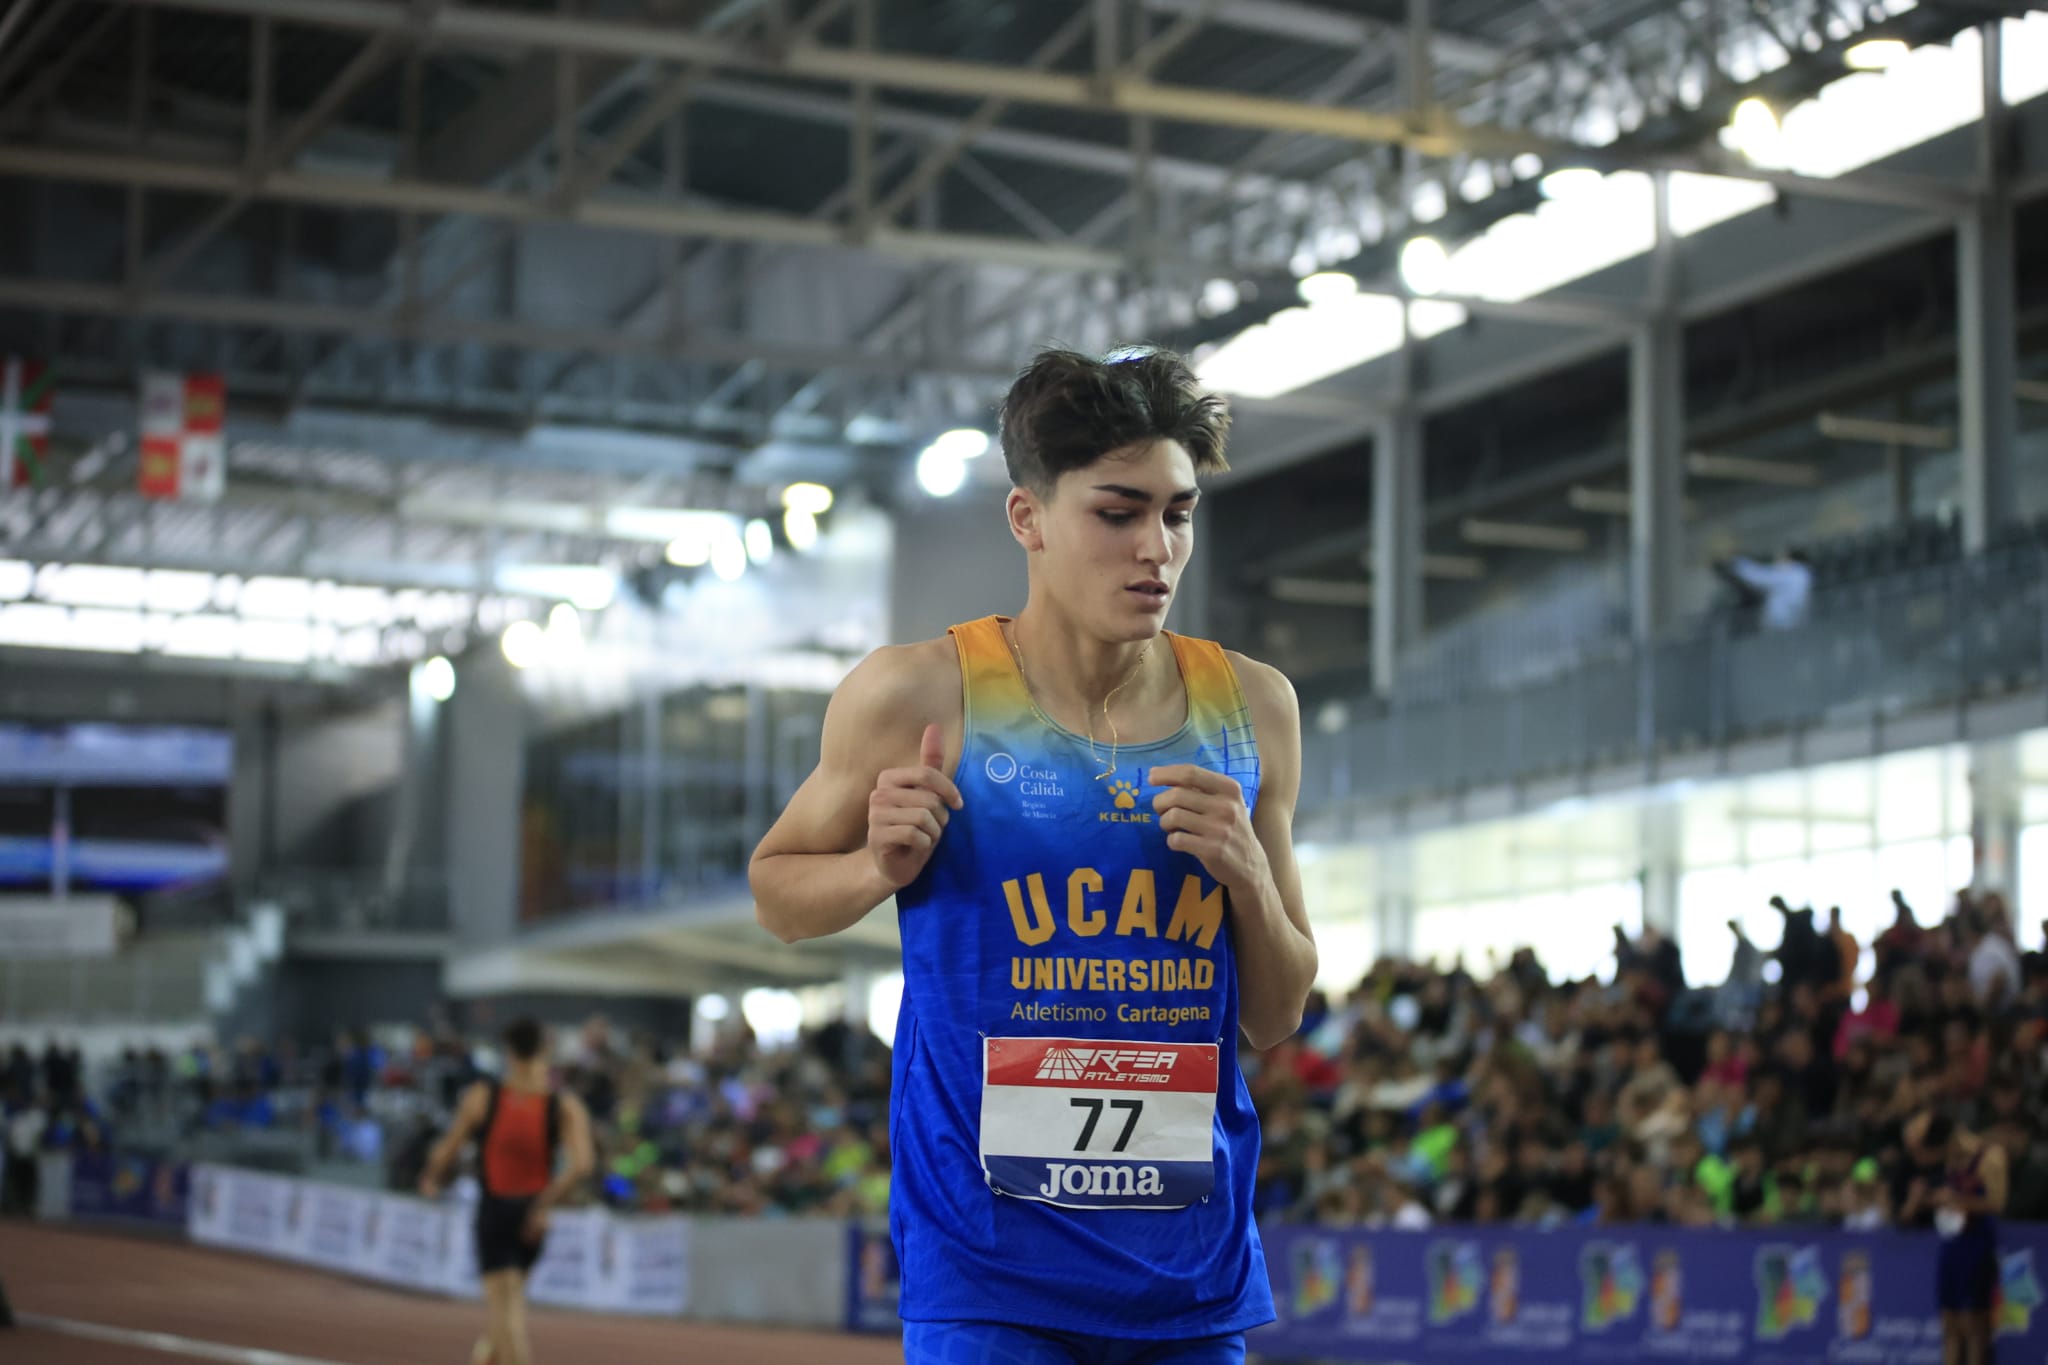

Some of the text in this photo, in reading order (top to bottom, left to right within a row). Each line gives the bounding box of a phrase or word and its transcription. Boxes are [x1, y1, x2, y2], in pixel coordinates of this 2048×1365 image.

[1020, 765, 1057, 780] Costa
[1020, 781, 1064, 796] Cálida
[1099, 812, 1152, 823] KELME
[1001, 867, 1224, 950] UCAM
[1011, 957, 1215, 991] UNIVERSIDAD
[1011, 1002, 1211, 1026] Atletismo Cartagena
[1089, 1049, 1178, 1072] RFEA
[1083, 1071, 1170, 1083] ATLETISMO
[1070, 1097, 1143, 1152] 77
